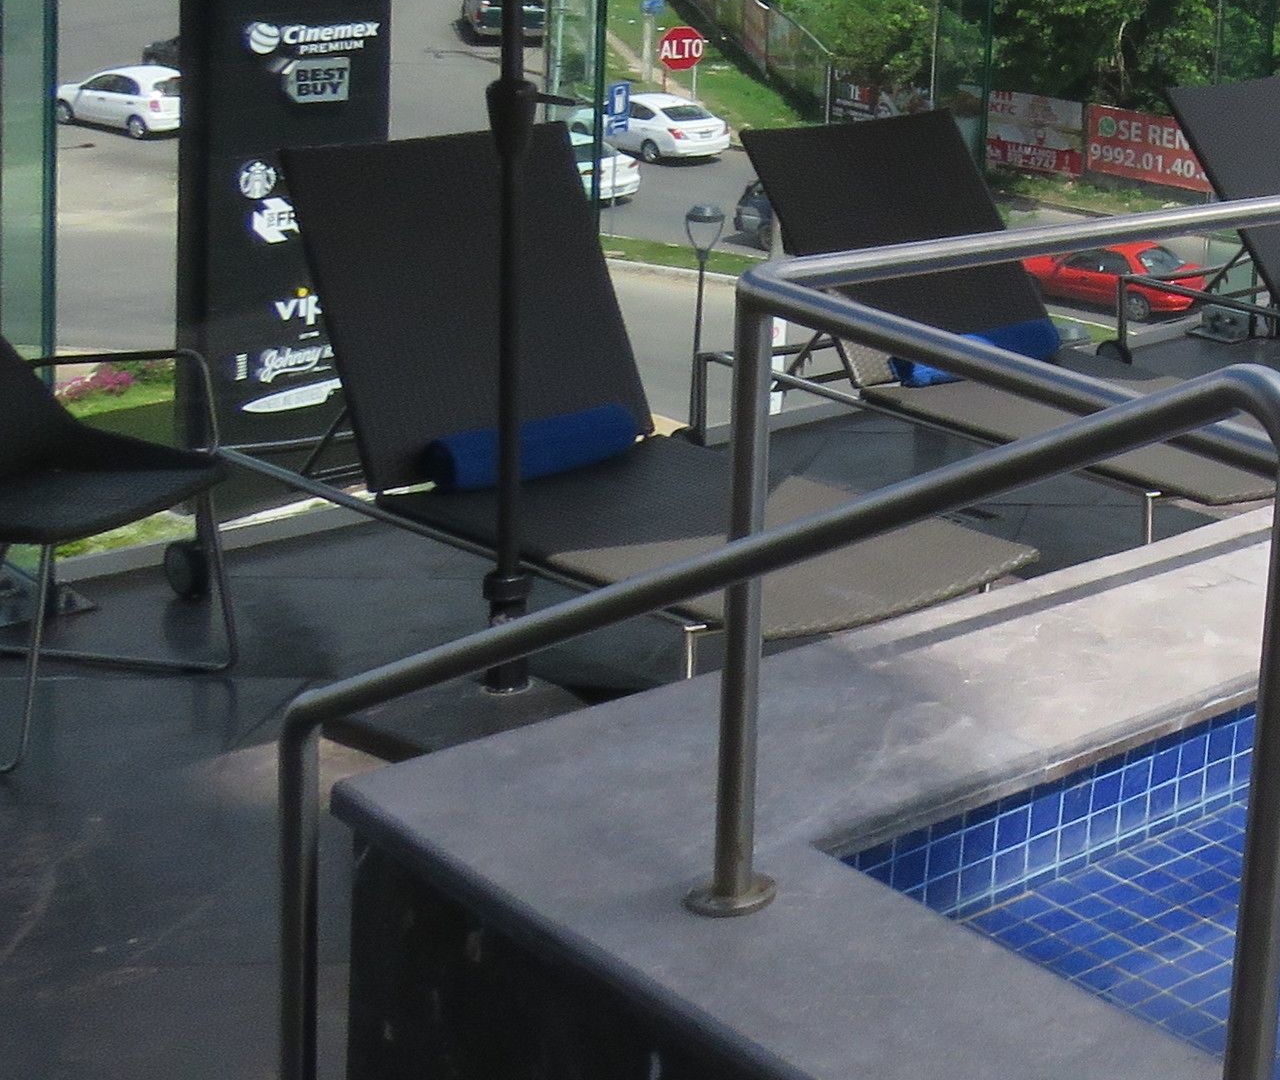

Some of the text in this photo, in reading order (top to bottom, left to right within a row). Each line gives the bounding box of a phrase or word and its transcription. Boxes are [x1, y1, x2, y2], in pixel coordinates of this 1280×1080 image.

[283, 22, 380, 45] Cinemex
[300, 40, 364, 55] PREMIUM
[660, 38, 703, 59] ALTO
[296, 67, 348, 82] BEST
[297, 81, 342, 97] BUY
[1118, 120, 1142, 142] SE
[259, 346, 322, 383] Johnny
